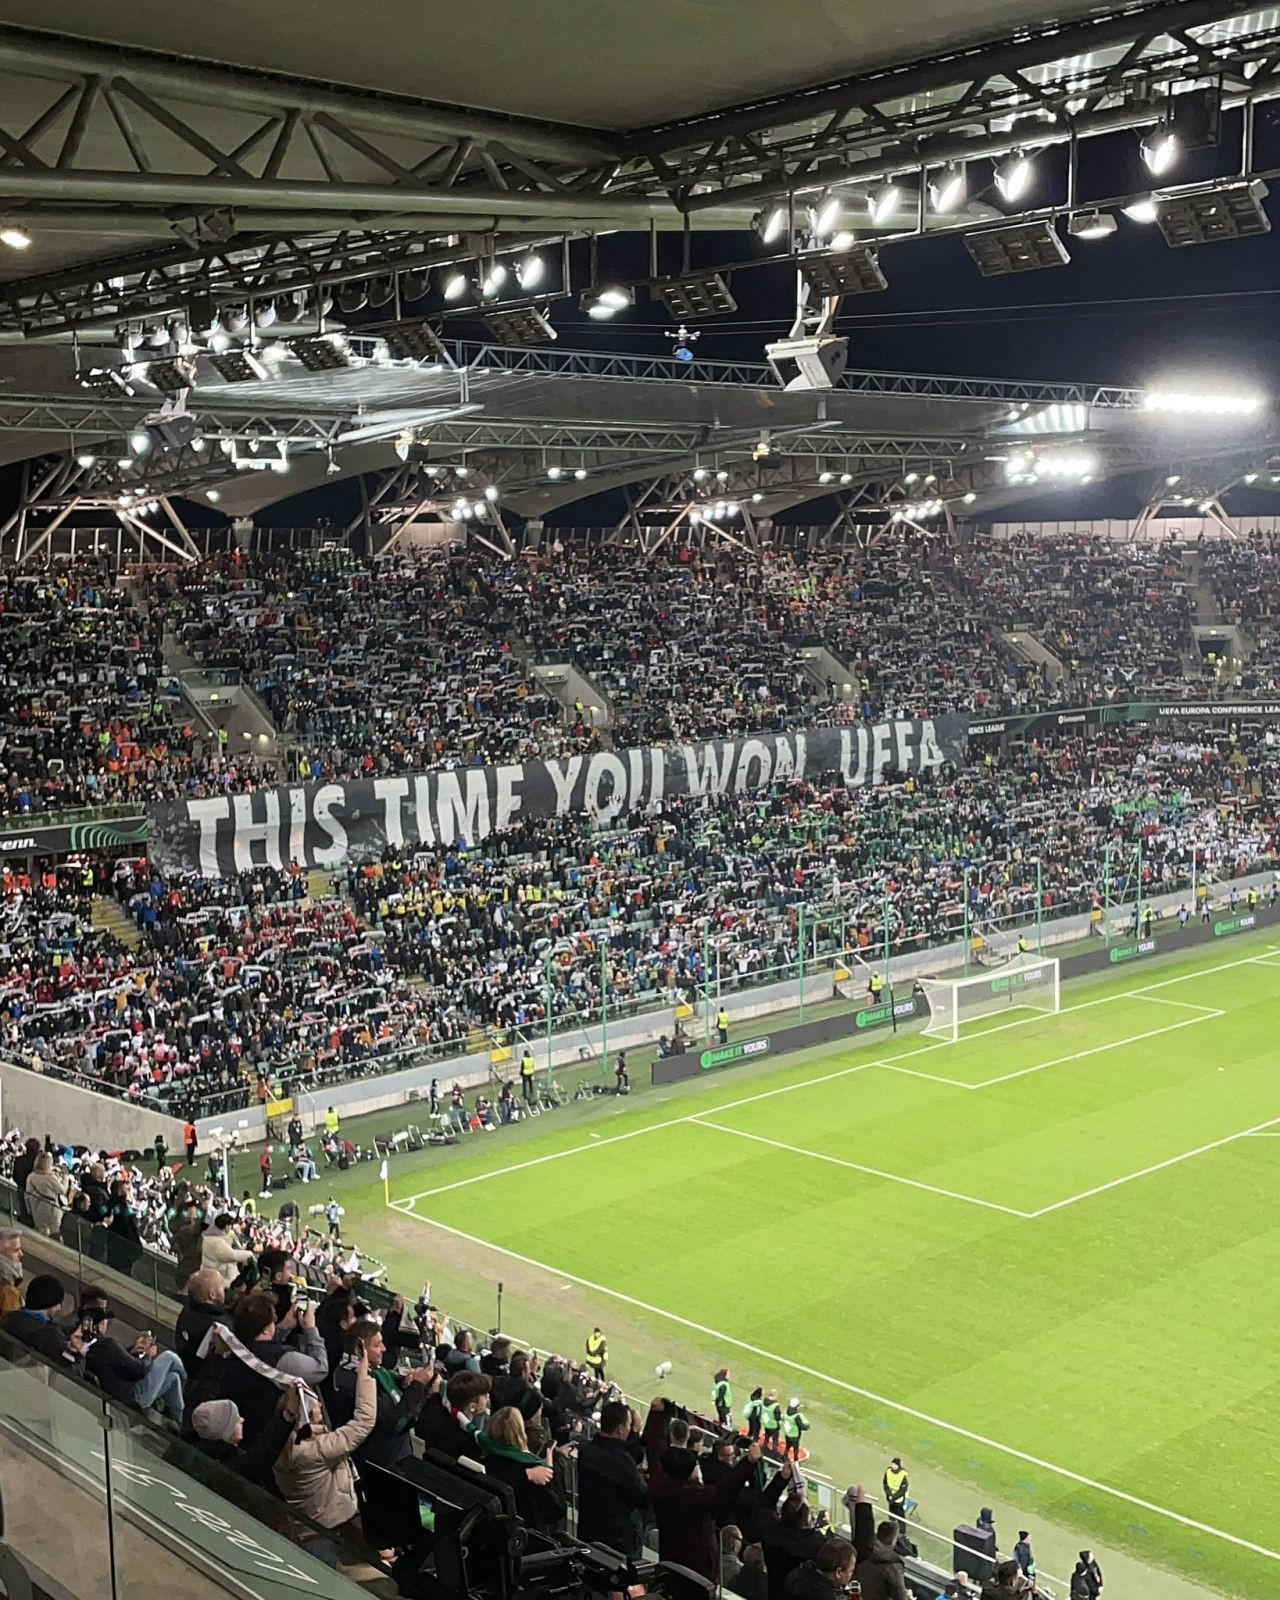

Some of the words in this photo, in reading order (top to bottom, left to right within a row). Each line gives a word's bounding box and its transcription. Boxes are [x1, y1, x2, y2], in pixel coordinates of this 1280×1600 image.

[1159, 707, 1179, 715] UEFA
[1181, 706, 1211, 715] EUROPA
[1212, 706, 1263, 714] CONFERENCE
[187, 784, 349, 880] THIS
[374, 764, 524, 850] TIME
[544, 748, 665, 823] YOU
[684, 734, 806, 801] WON
[840, 720, 946, 788] UEFA
